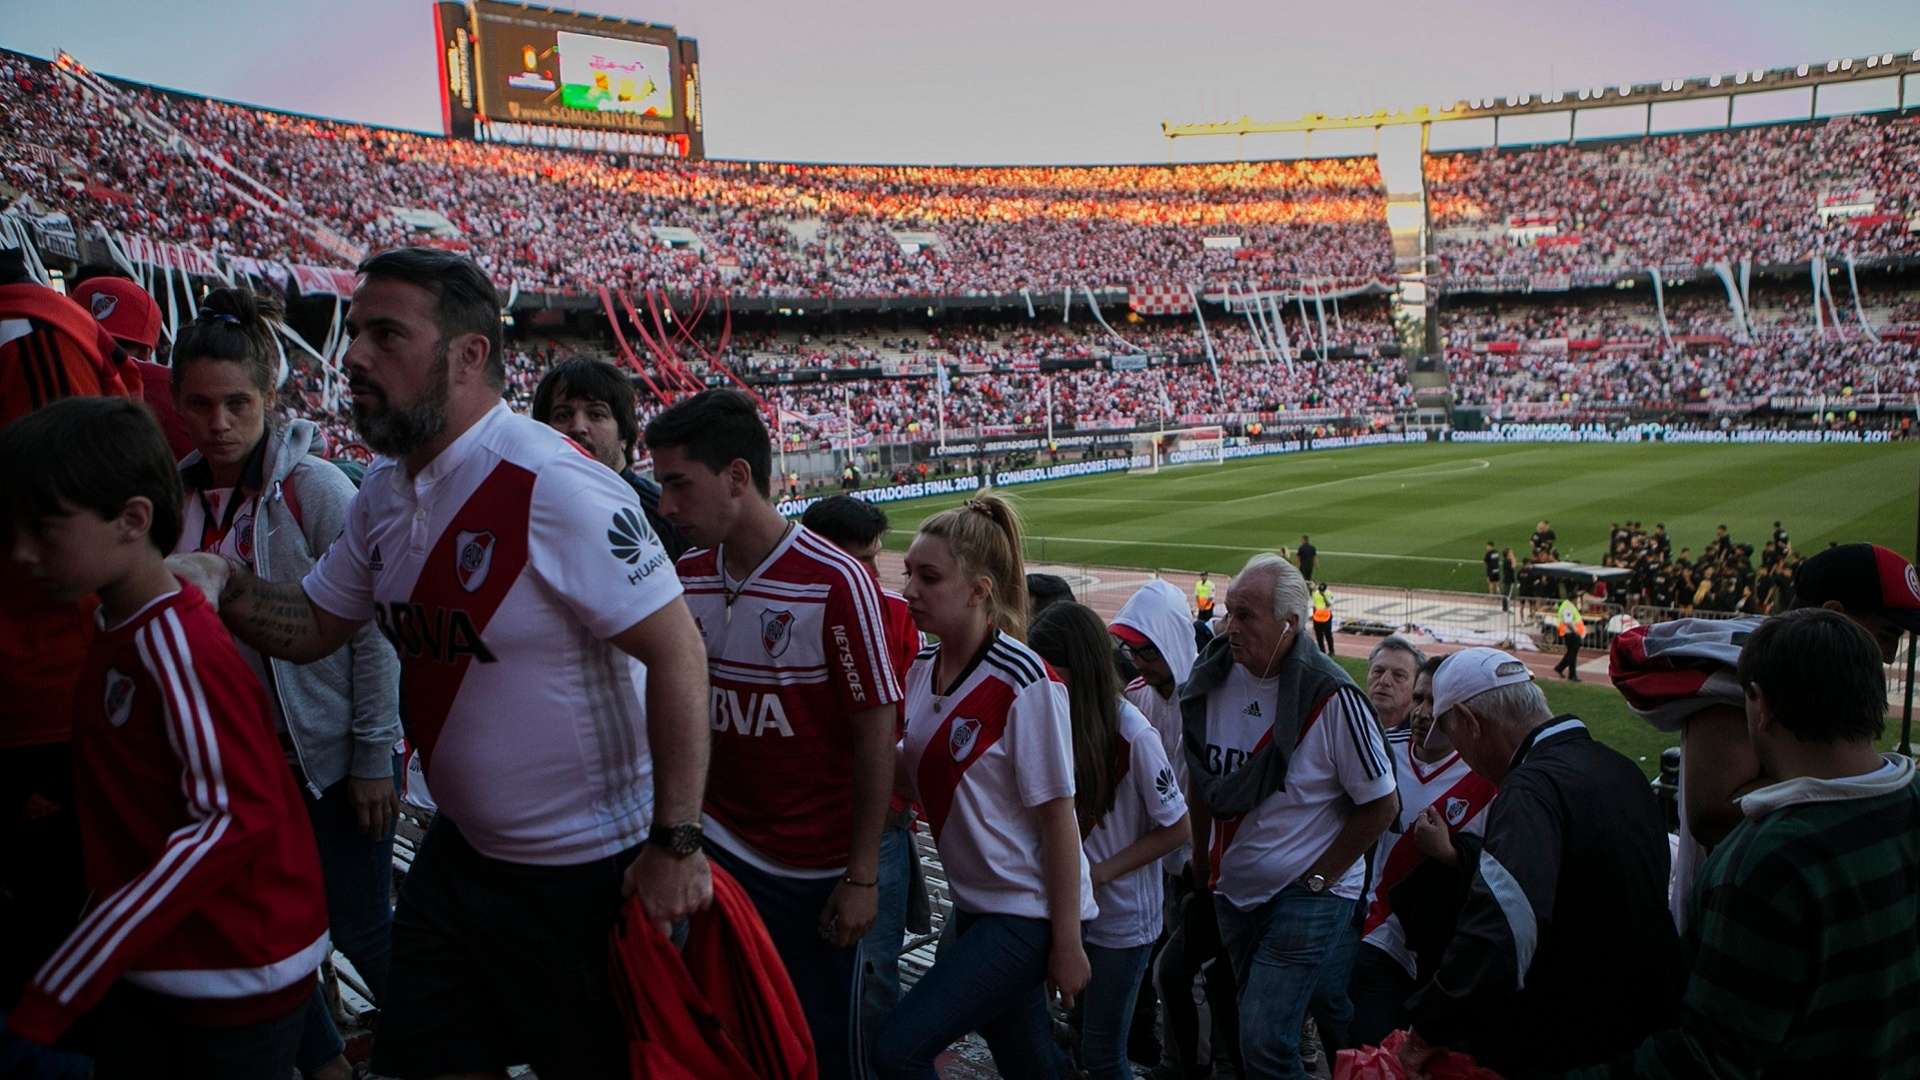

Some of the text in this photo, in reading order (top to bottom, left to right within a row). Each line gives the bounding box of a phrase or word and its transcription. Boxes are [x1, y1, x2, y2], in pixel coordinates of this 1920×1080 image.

[1405, 431, 1427, 443] 2018
[1730, 430, 1822, 443] LIBERTADORES
[1824, 430, 1862, 443] FINAL
[997, 469, 1047, 484] CONMEBOL
[1047, 460, 1106, 479] LIBERTADORES
[1107, 457, 1130, 472] FINAL
[776, 496, 823, 517] CONM
[925, 479, 954, 495] FINAL
[954, 475, 979, 491] 2018
[628, 553, 668, 586] HUAW
[831, 624, 866, 704] NETSHOES
[710, 685, 796, 737] BVA
